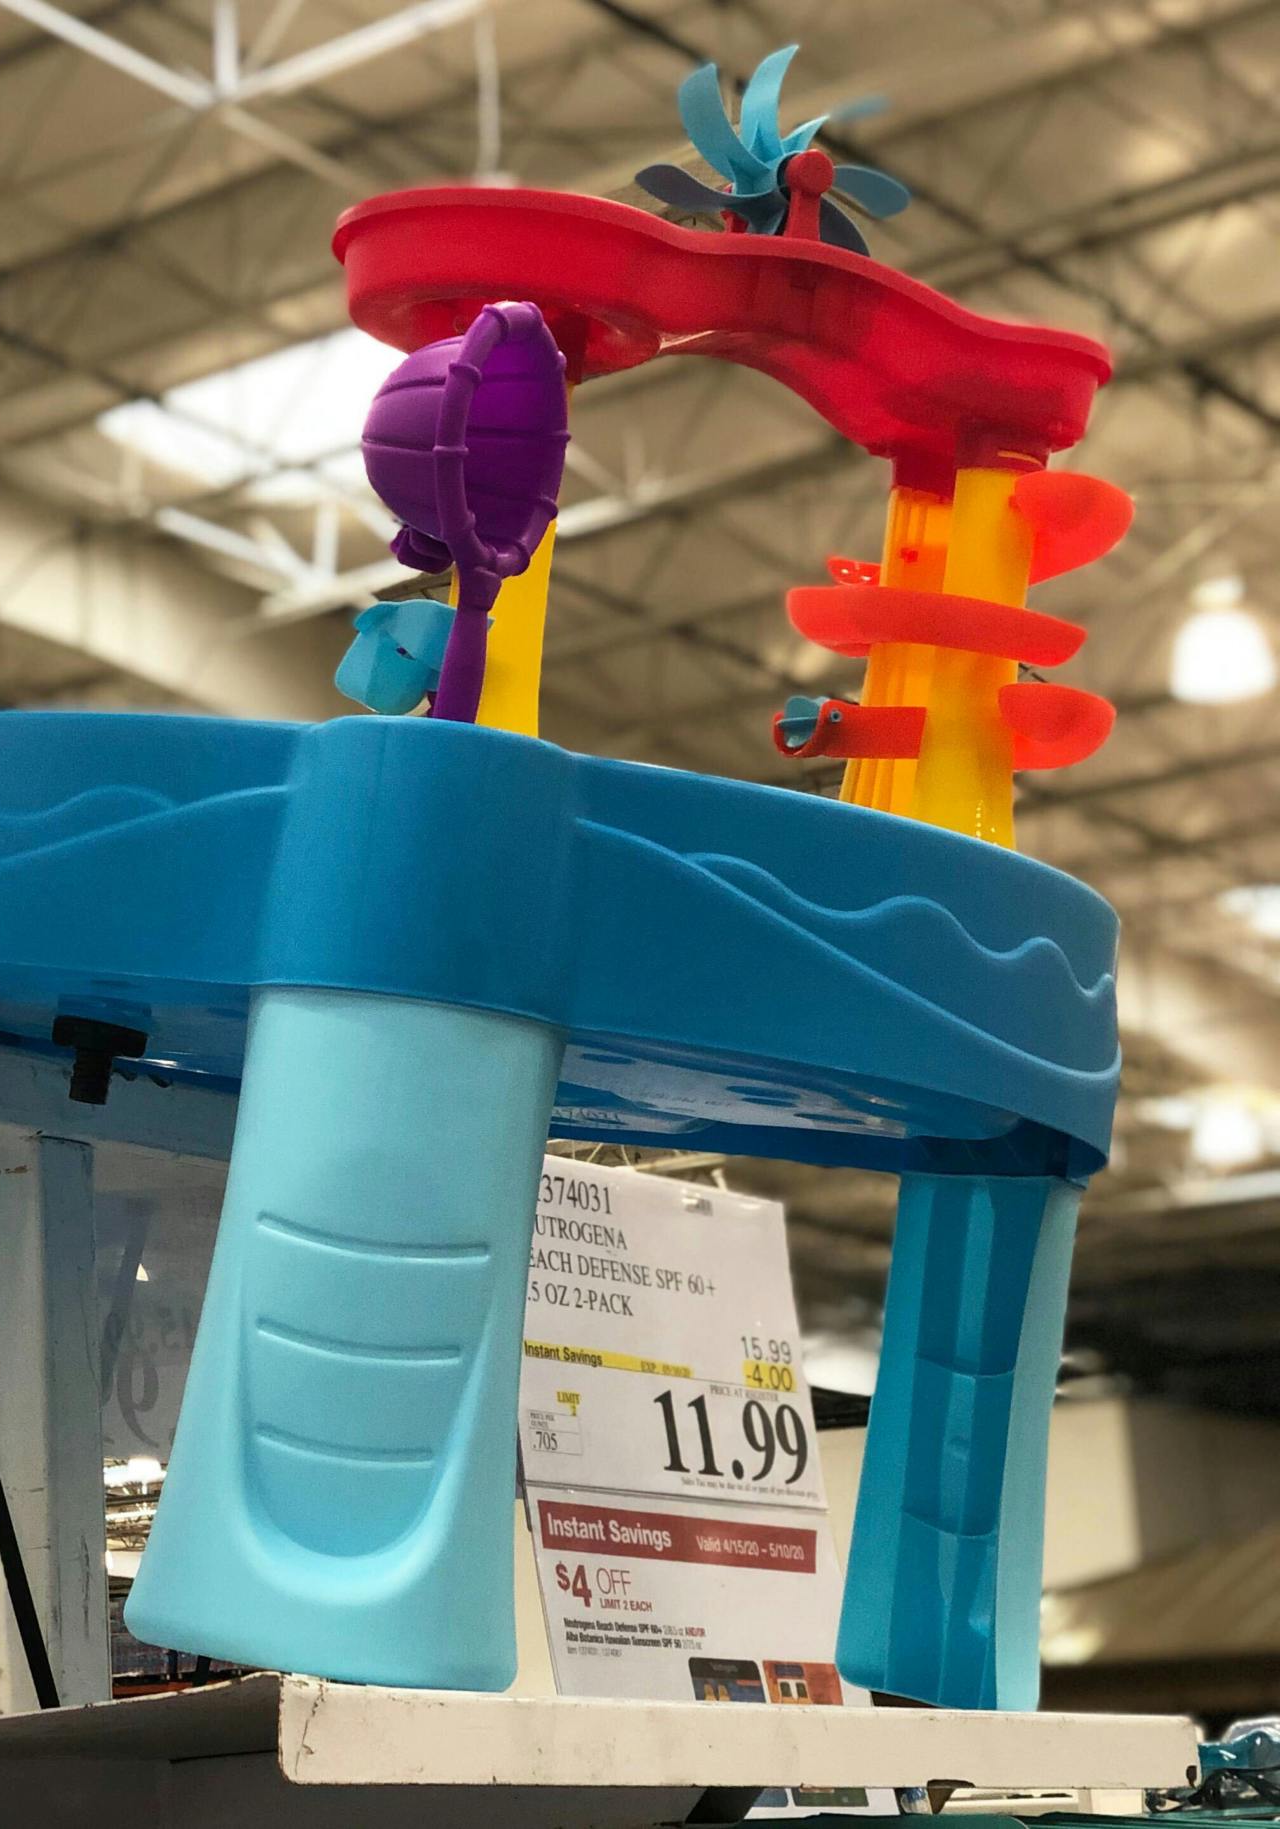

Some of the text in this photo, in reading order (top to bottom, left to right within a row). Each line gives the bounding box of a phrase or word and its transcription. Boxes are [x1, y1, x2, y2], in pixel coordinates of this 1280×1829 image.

[537, 1174, 613, 1215] 374031
[577, 1254, 652, 1287] DEFENSE
[655, 1268, 683, 1291] SPF
[687, 1272, 716, 1297] 60+
[545, 1283, 570, 1306] OZ
[574, 1287, 634, 1316] 2-PACK
[524, 1340, 561, 1361] Instant
[563, 1347, 603, 1368] Savings
[741, 1336, 792, 1363] 15.99
[746, 1367, 794, 1391] -4.00
[532, 1431, 558, 1451] .705
[653, 1389, 808, 1485] 11.99
[547, 1512, 606, 1541] Instant
[609, 1519, 672, 1551] Savings
[696, 1535, 721, 1552] Valid
[722, 1540, 760, 1557] 4/15/20
[769, 1542, 805, 1561] 5/10/20
[554, 1560, 631, 1608] $4 OFF
[600, 1598, 652, 1613] LIMIT 2 EACH
